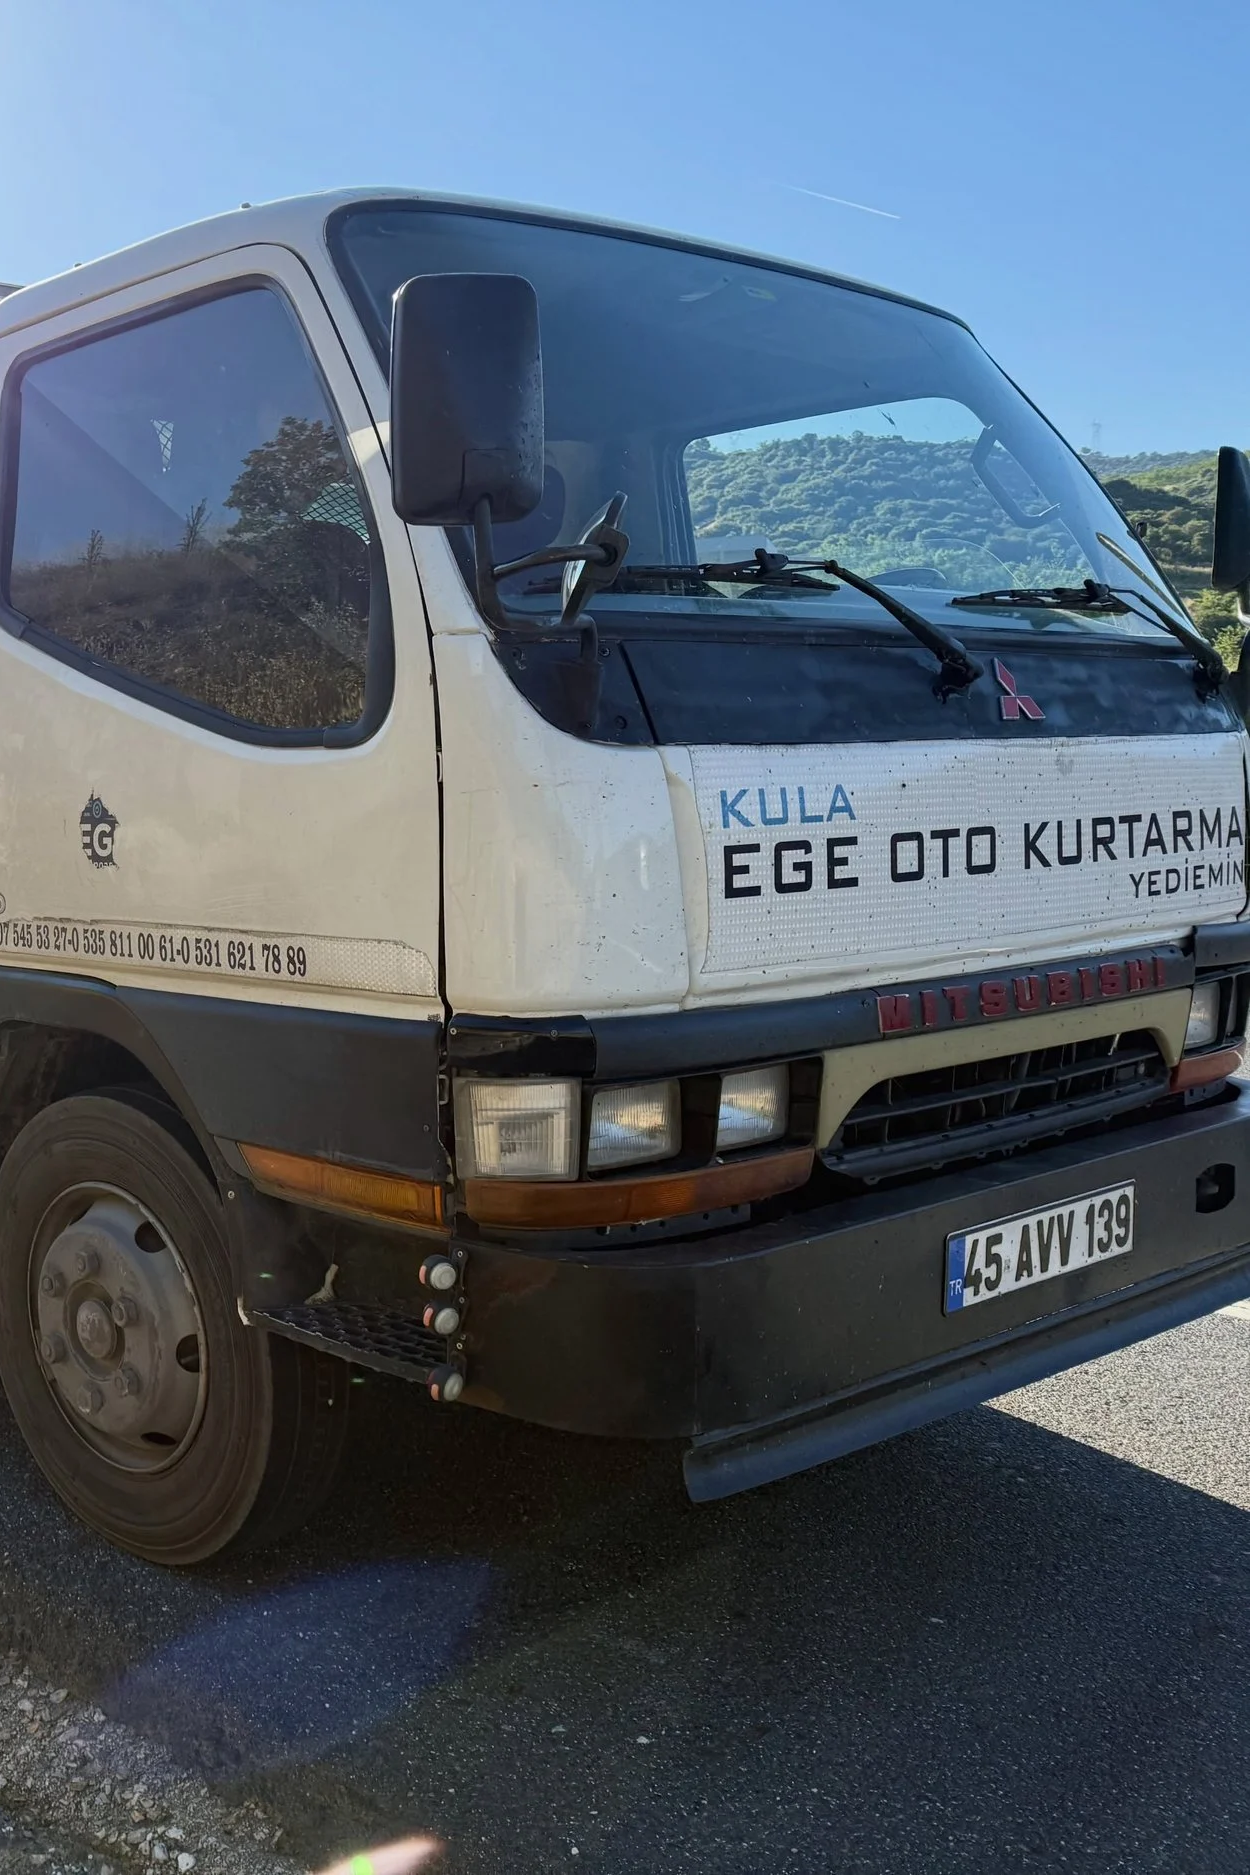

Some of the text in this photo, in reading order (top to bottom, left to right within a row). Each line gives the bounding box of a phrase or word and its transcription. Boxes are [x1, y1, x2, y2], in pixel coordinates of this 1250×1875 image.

[719, 784, 856, 829] KULA
[724, 805, 1244, 899] EGE OTO KURTARMA
[1129, 852, 1244, 899] YEDİEMİN
[13, 922, 33, 949] 545
[36, 924, 50, 950] 53
[83, 928, 106, 956] 535
[109, 930, 134, 958] 811
[137, 932, 155, 961] 00
[195, 937, 222, 968] 531
[227, 940, 256, 971] 621
[262, 943, 282, 975] 78
[287, 945, 307, 977] 89
[875, 956, 1166, 1033] MITSUBISHI
[950, 1193, 1131, 1297] TR 45 AVV 139
